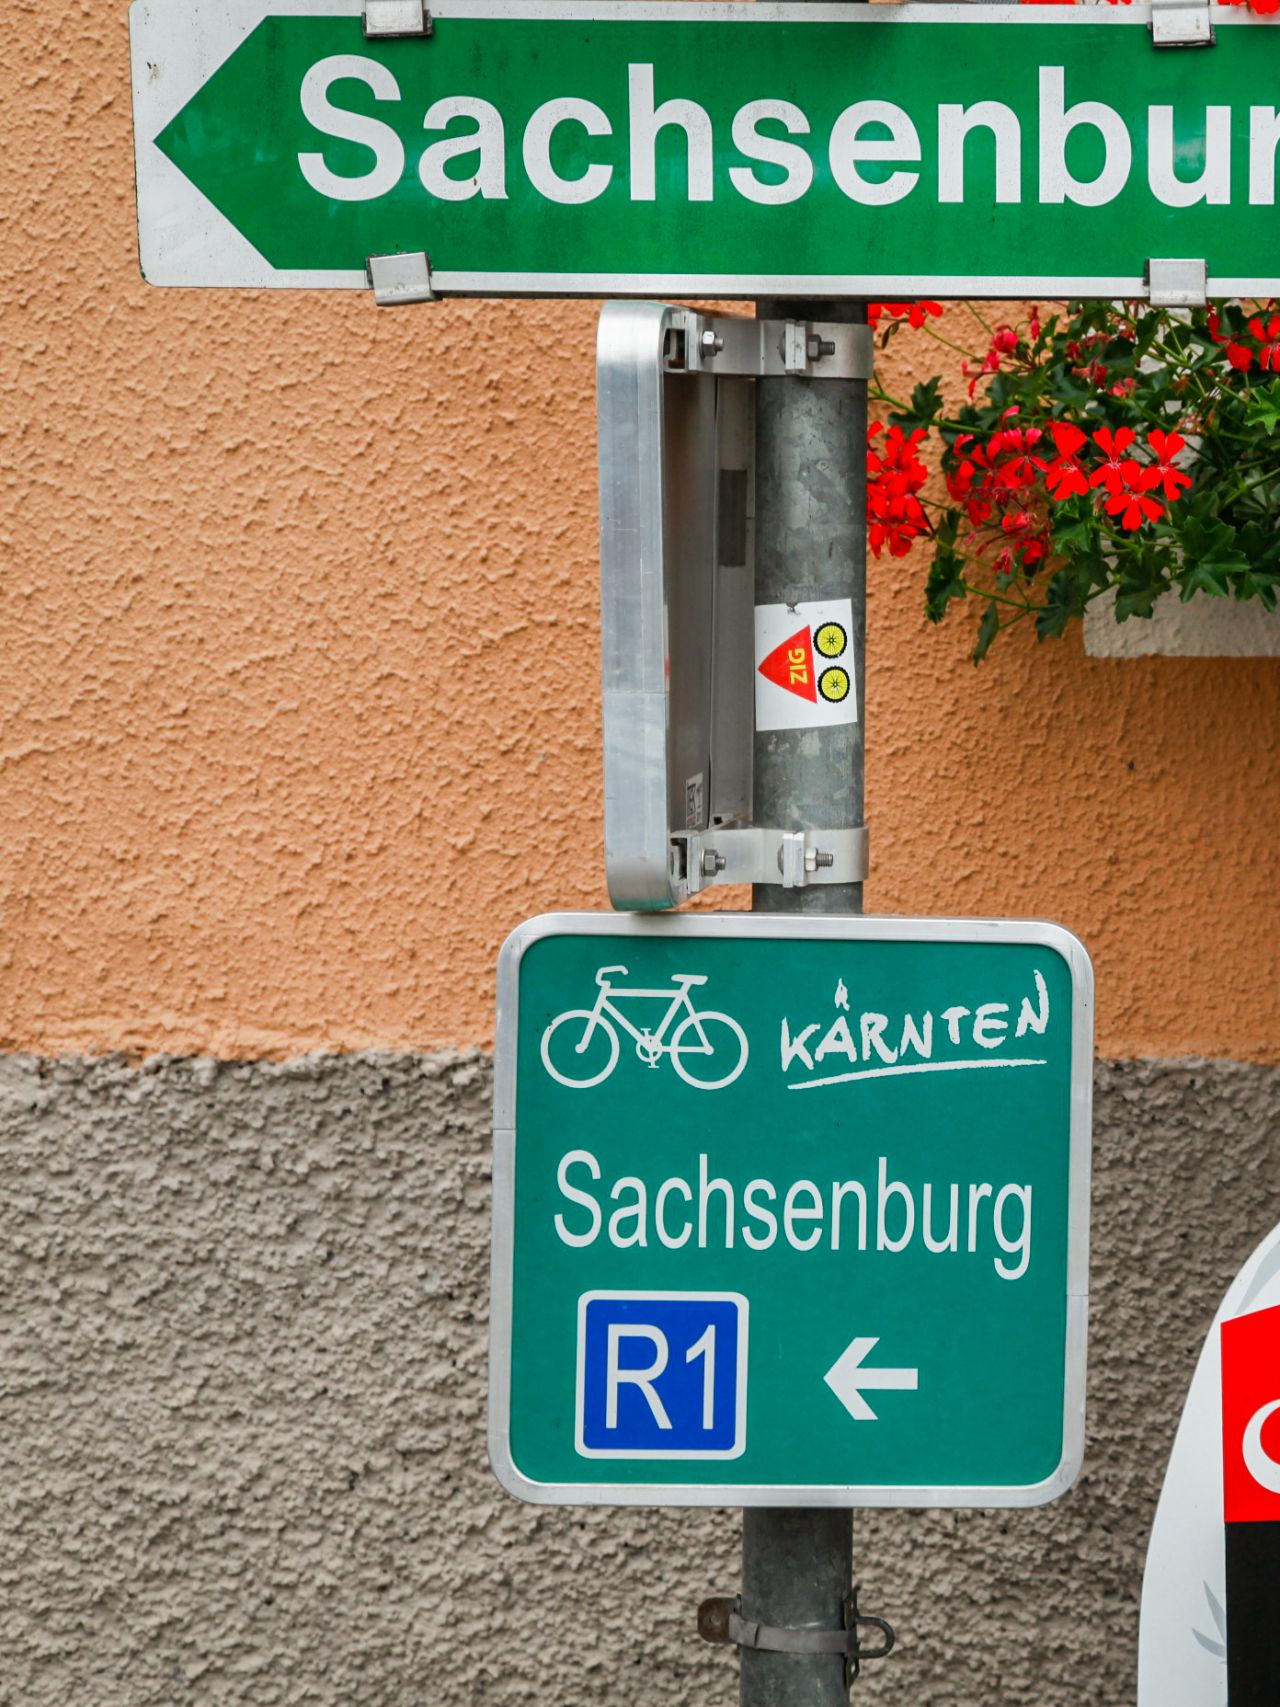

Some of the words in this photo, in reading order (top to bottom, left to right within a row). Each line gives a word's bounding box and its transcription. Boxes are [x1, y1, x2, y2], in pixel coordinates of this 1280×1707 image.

[787, 647, 808, 685] ZIG
[554, 1149, 1032, 1280] Sachsenburg
[605, 1324, 716, 1430] R1
